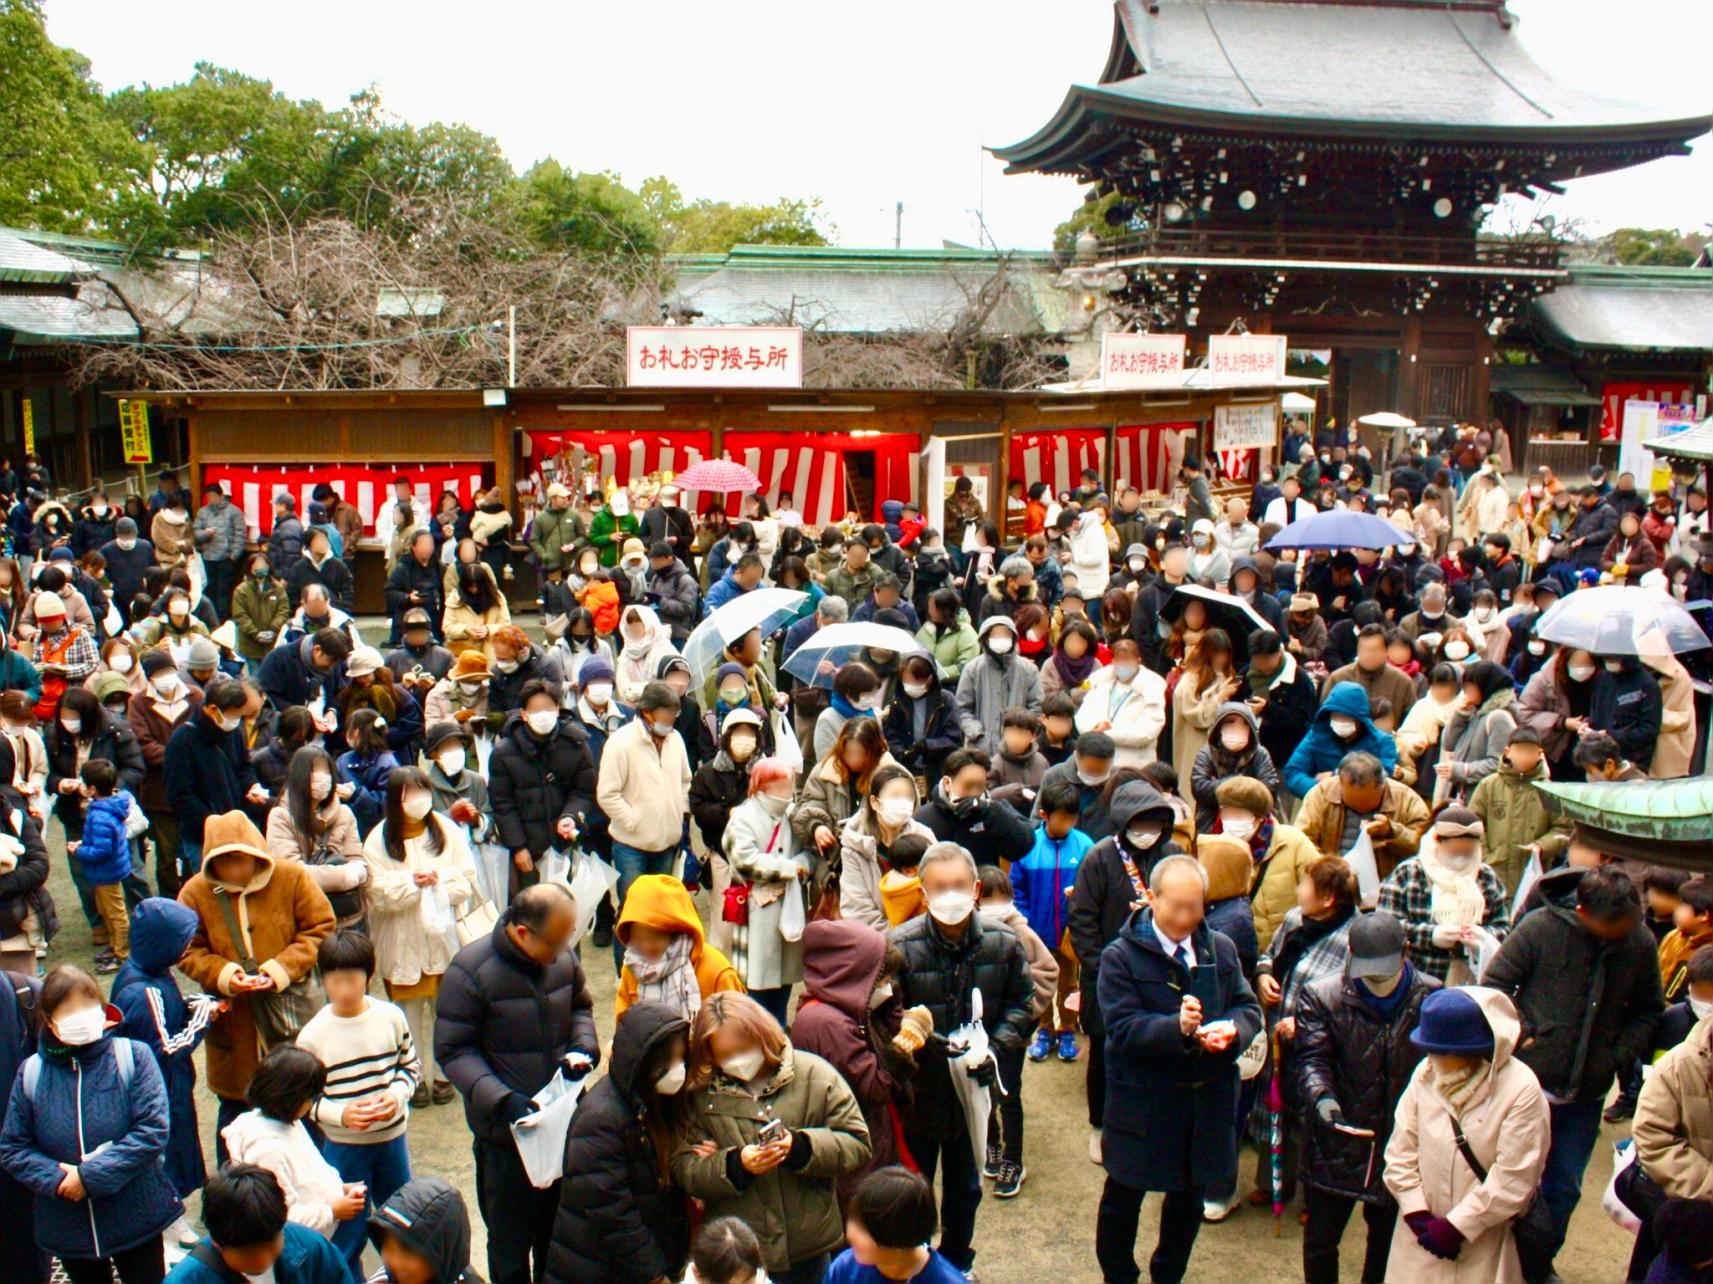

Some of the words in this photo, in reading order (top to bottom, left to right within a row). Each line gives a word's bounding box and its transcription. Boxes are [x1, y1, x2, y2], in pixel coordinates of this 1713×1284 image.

[640, 344, 788, 371] お札お守授与所
[1110, 351, 1179, 374] お札お守授与所
[1214, 352, 1275, 374] お札お守授与所
